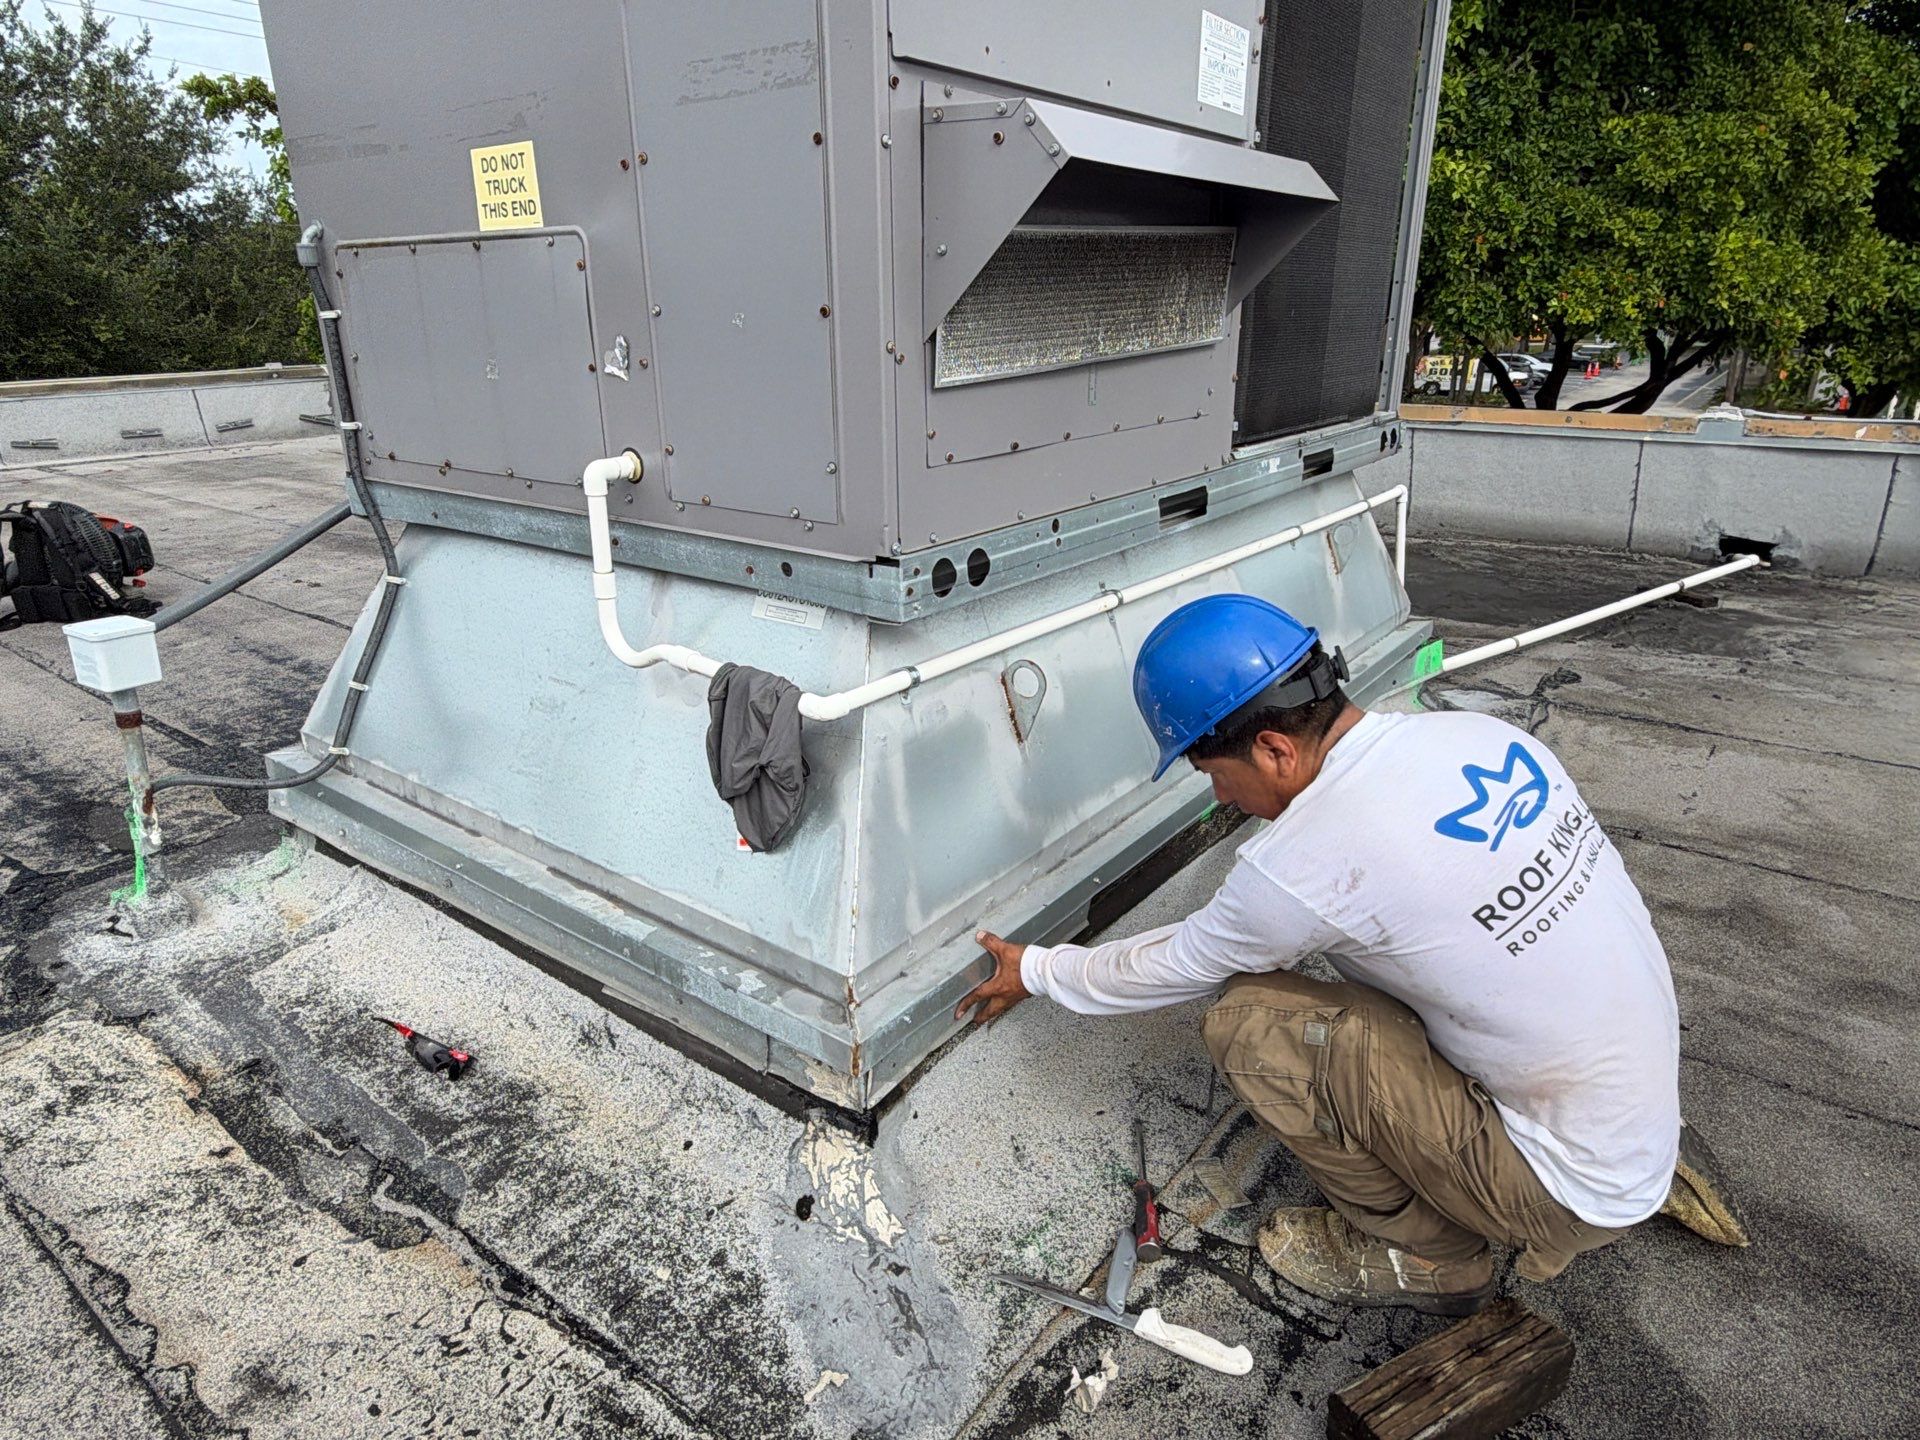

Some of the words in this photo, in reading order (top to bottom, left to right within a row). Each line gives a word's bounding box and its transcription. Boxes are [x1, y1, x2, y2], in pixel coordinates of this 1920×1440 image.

[1205, 14, 1223, 30] FILTER
[1224, 23, 1247, 42] SECTION
[1207, 58, 1239, 78] IMPORTANT
[481, 155, 498, 173] DO
[501, 152, 525, 171] NOT
[485, 176, 527, 196] TRUCK
[481, 201, 509, 219] THIS
[511, 199, 537, 217] END
[1471, 848, 1555, 933] ROOF
[1505, 881, 1585, 957] ROOFING
[1580, 869, 1591, 883] &
